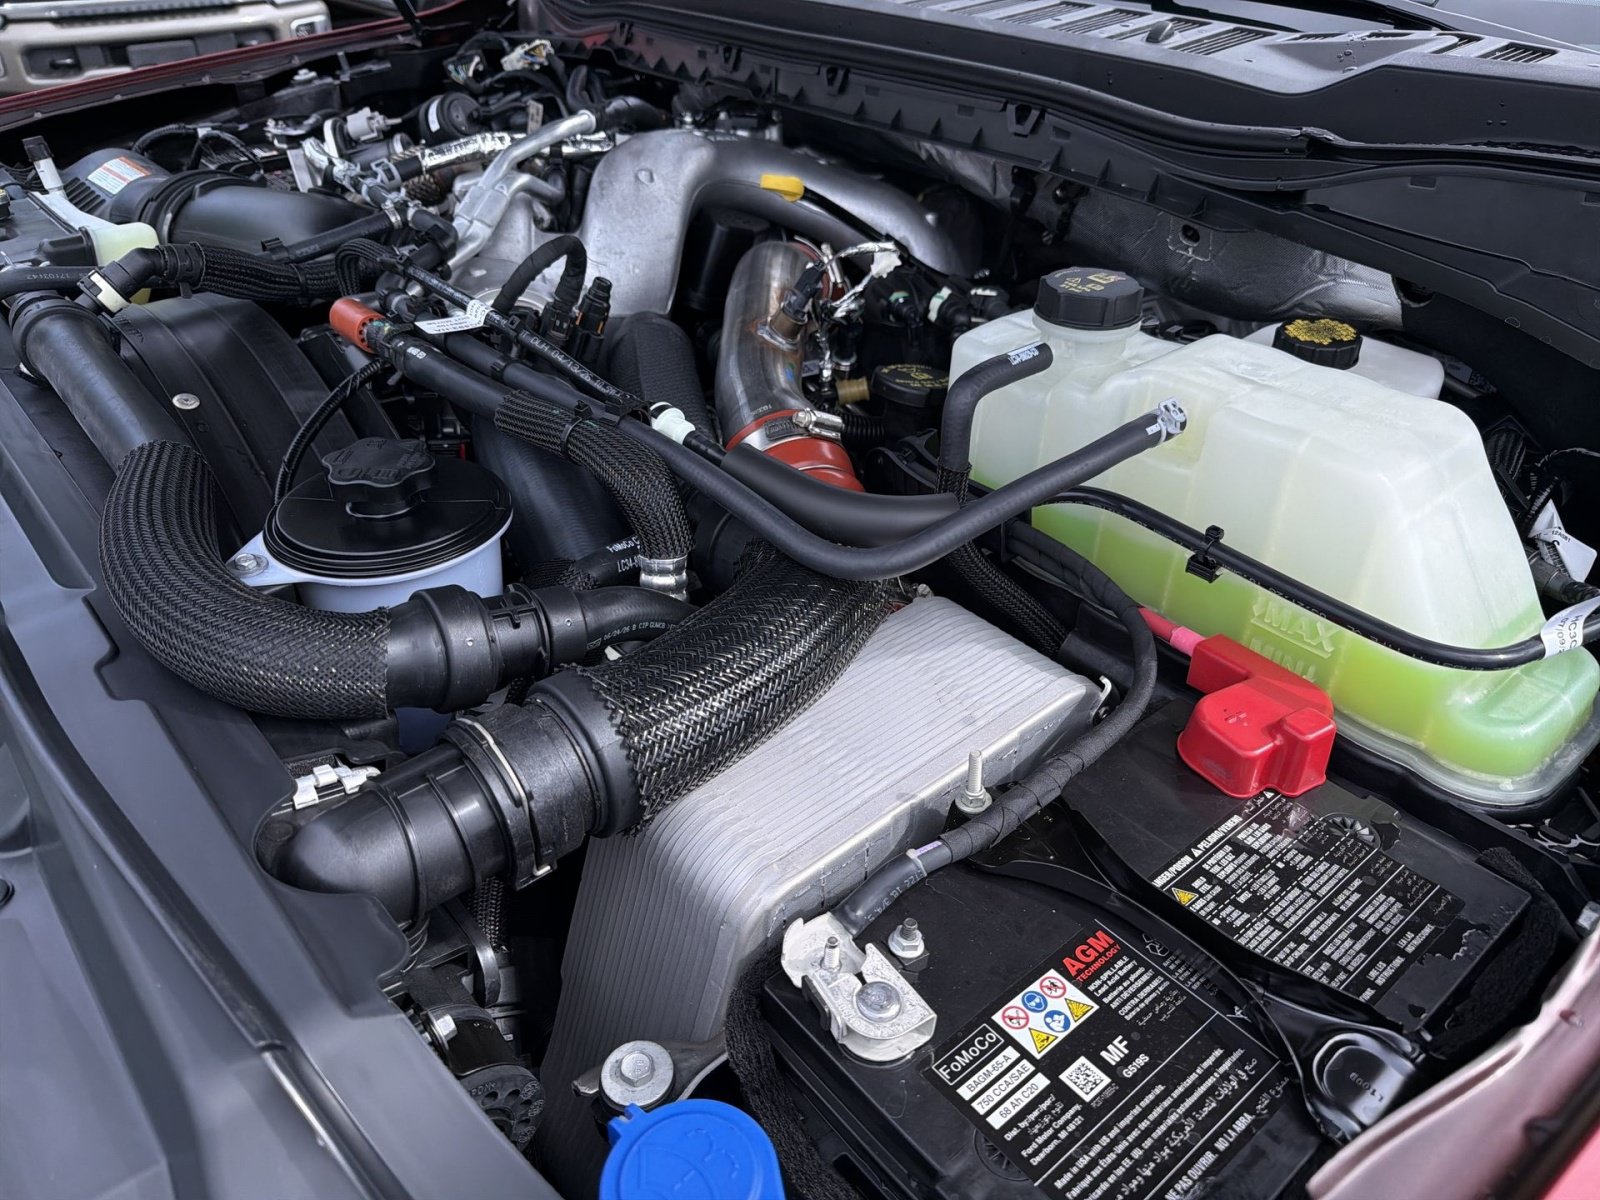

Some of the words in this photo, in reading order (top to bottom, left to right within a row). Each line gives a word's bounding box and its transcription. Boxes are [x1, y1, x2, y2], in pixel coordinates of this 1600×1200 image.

[1263, 599, 1335, 653] MAX
[1195, 814, 1244, 851] PELIGRO/VENENO
[1058, 929, 1115, 976] AGM
[1396, 938, 1408, 948] LEA
[1402, 931, 1415, 941] LAS
[1076, 943, 1122, 982] TECHNOLOGY
[1086, 955, 1129, 991] NON-SPILLABLE
[1093, 983, 1109, 996] Lead
[1105, 973, 1120, 986] Acid
[1117, 959, 1138, 977] Battery
[1365, 968, 1380, 980] LIRE
[1374, 960, 1387, 971] LES
[1373, 954, 1406, 986] INSTRUCTIONS.
[1101, 984, 1124, 1003] Batterie
[1127, 965, 1146, 982] plomb
[1117, 996, 1140, 1016] CONTRA
[1136, 975, 1164, 999] DERRAMES
[1109, 996, 1123, 1009] ANTI
[938, 1028, 997, 1080] FoMoCo
[1099, 1034, 1134, 1066] MF
[1121, 1052, 1150, 1079] G519S
[1199, 1045, 1225, 1070] importés.
[966, 1052, 1011, 1093] BAGM-65-A
[976, 1093, 995, 1110] 750
[991, 1062, 1030, 1097] CCA/SAE
[1169, 1070, 1199, 1099] américains
[1194, 1065, 1204, 1075] et
[998, 1106, 1011, 1119] 68
[1009, 1095, 1024, 1109] Ah
[1020, 1082, 1039, 1099] C20
[1106, 1172, 1117, 1183] en
[1112, 1163, 1125, 1177] los
[1121, 1154, 1135, 1168] EE.
[1129, 1144, 1145, 1160] UU.
[1140, 1136, 1154, 1150] con
[1149, 1110, 1180, 1140] materiales
[1175, 1074, 1217, 1115] estadounidenses
[1215, 1045, 1246, 1075] importados.
[1145, 1094, 1174, 1122] matériaux
[1003, 1124, 1021, 1141] Dist.
[1020, 1140, 1038, 1158] Ford
[1034, 1125, 1055, 1145] Motor
[1051, 1100, 1083, 1130] Company,
[1029, 1135, 1062, 1166] Dearborn,
[1057, 1129, 1069, 1140] MI
[1065, 1114, 1085, 1133] 48121
[1053, 1169, 1073, 1189] Made
[1069, 1164, 1079, 1174] in
[1075, 1153, 1091, 1169] USA
[1086, 1142, 1102, 1158] with
[1098, 1134, 1110, 1147] US
[1106, 1125, 1120, 1139] and
[1116, 1104, 1143, 1130] imported
[1137, 1081, 1166, 1108] materials.
[1126, 1127, 1141, 1142] avec
[1136, 1117, 1150, 1131] des
[1096, 1136, 1129, 1168] États-Unis
[1173, 1174, 1193, 1194] PAS
[1186, 1147, 1219, 1180] OUVRIR.
[1213, 1136, 1230, 1152] NO
[1223, 1127, 1238, 1142] LA
[1231, 1109, 1256, 1133] ABRA.
[1064, 1172, 1094, 1200] Fabriqué
[1090, 1164, 1103, 1177] aux
